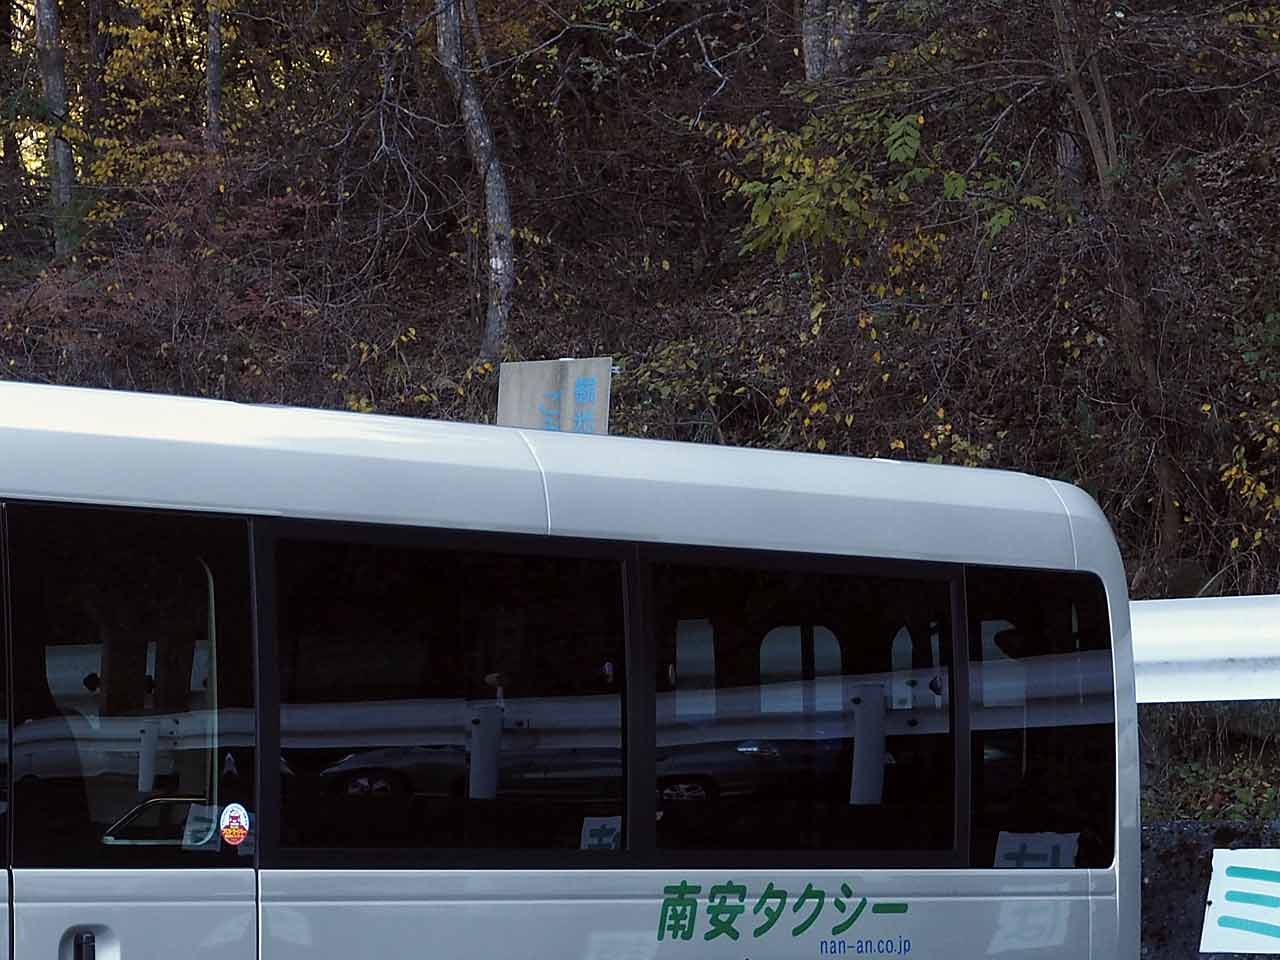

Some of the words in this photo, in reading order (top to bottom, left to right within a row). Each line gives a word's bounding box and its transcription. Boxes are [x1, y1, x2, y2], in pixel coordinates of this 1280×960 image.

[657, 880, 909, 941] 南安タクシー
[819, 935, 912, 956] nan-an.co.jp
